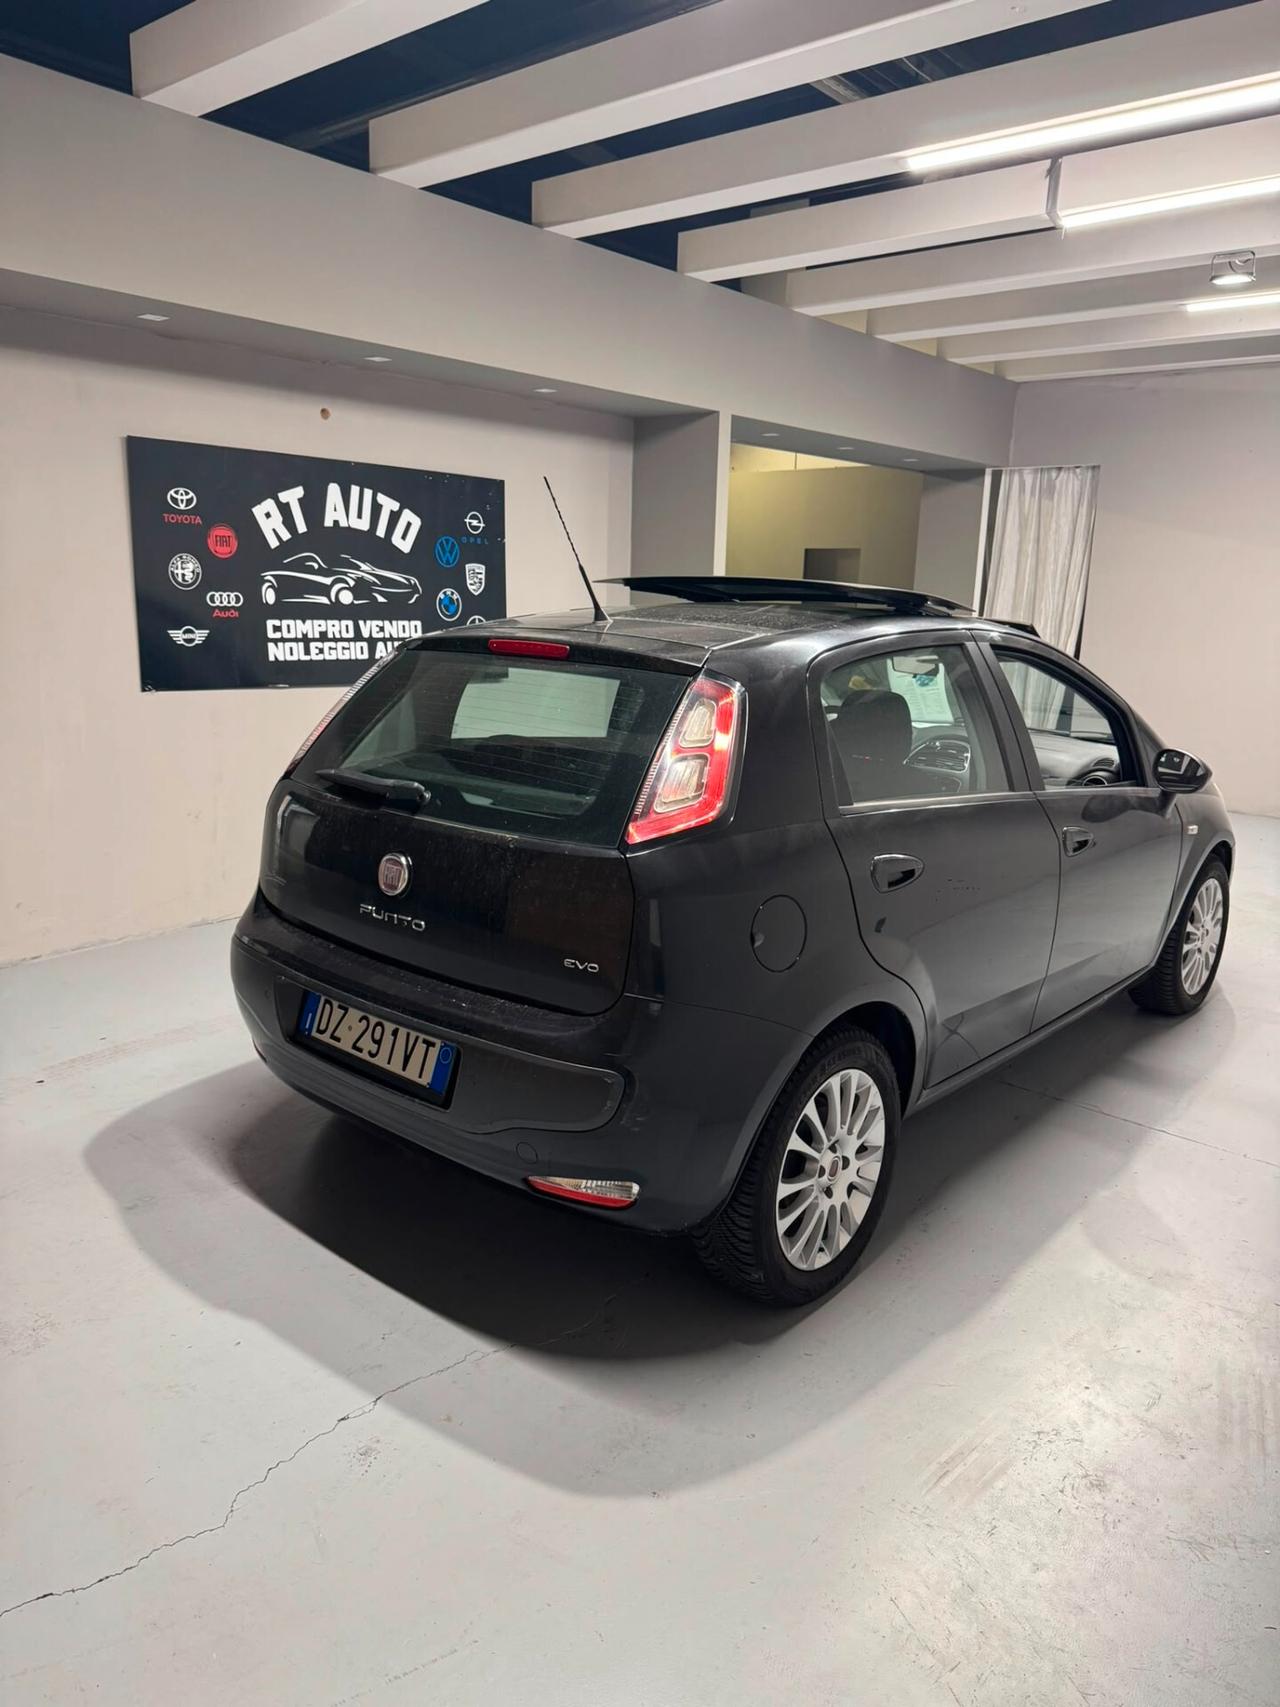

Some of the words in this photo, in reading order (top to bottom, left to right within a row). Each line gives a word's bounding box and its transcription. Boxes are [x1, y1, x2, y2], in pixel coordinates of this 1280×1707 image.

[163, 513, 202, 525] TOYOTA
[252, 485, 308, 549] RT
[324, 482, 422, 554] AUTO
[214, 535, 231, 547] FIAT
[461, 536, 489, 545] OPEL
[213, 608, 240, 618] Audi
[266, 619, 355, 639] COMPRO
[358, 619, 422, 640] VENDO
[267, 641, 369, 662] NOLEGGIO
[360, 903, 425, 931] PUNTO
[563, 958, 600, 973] EVO
